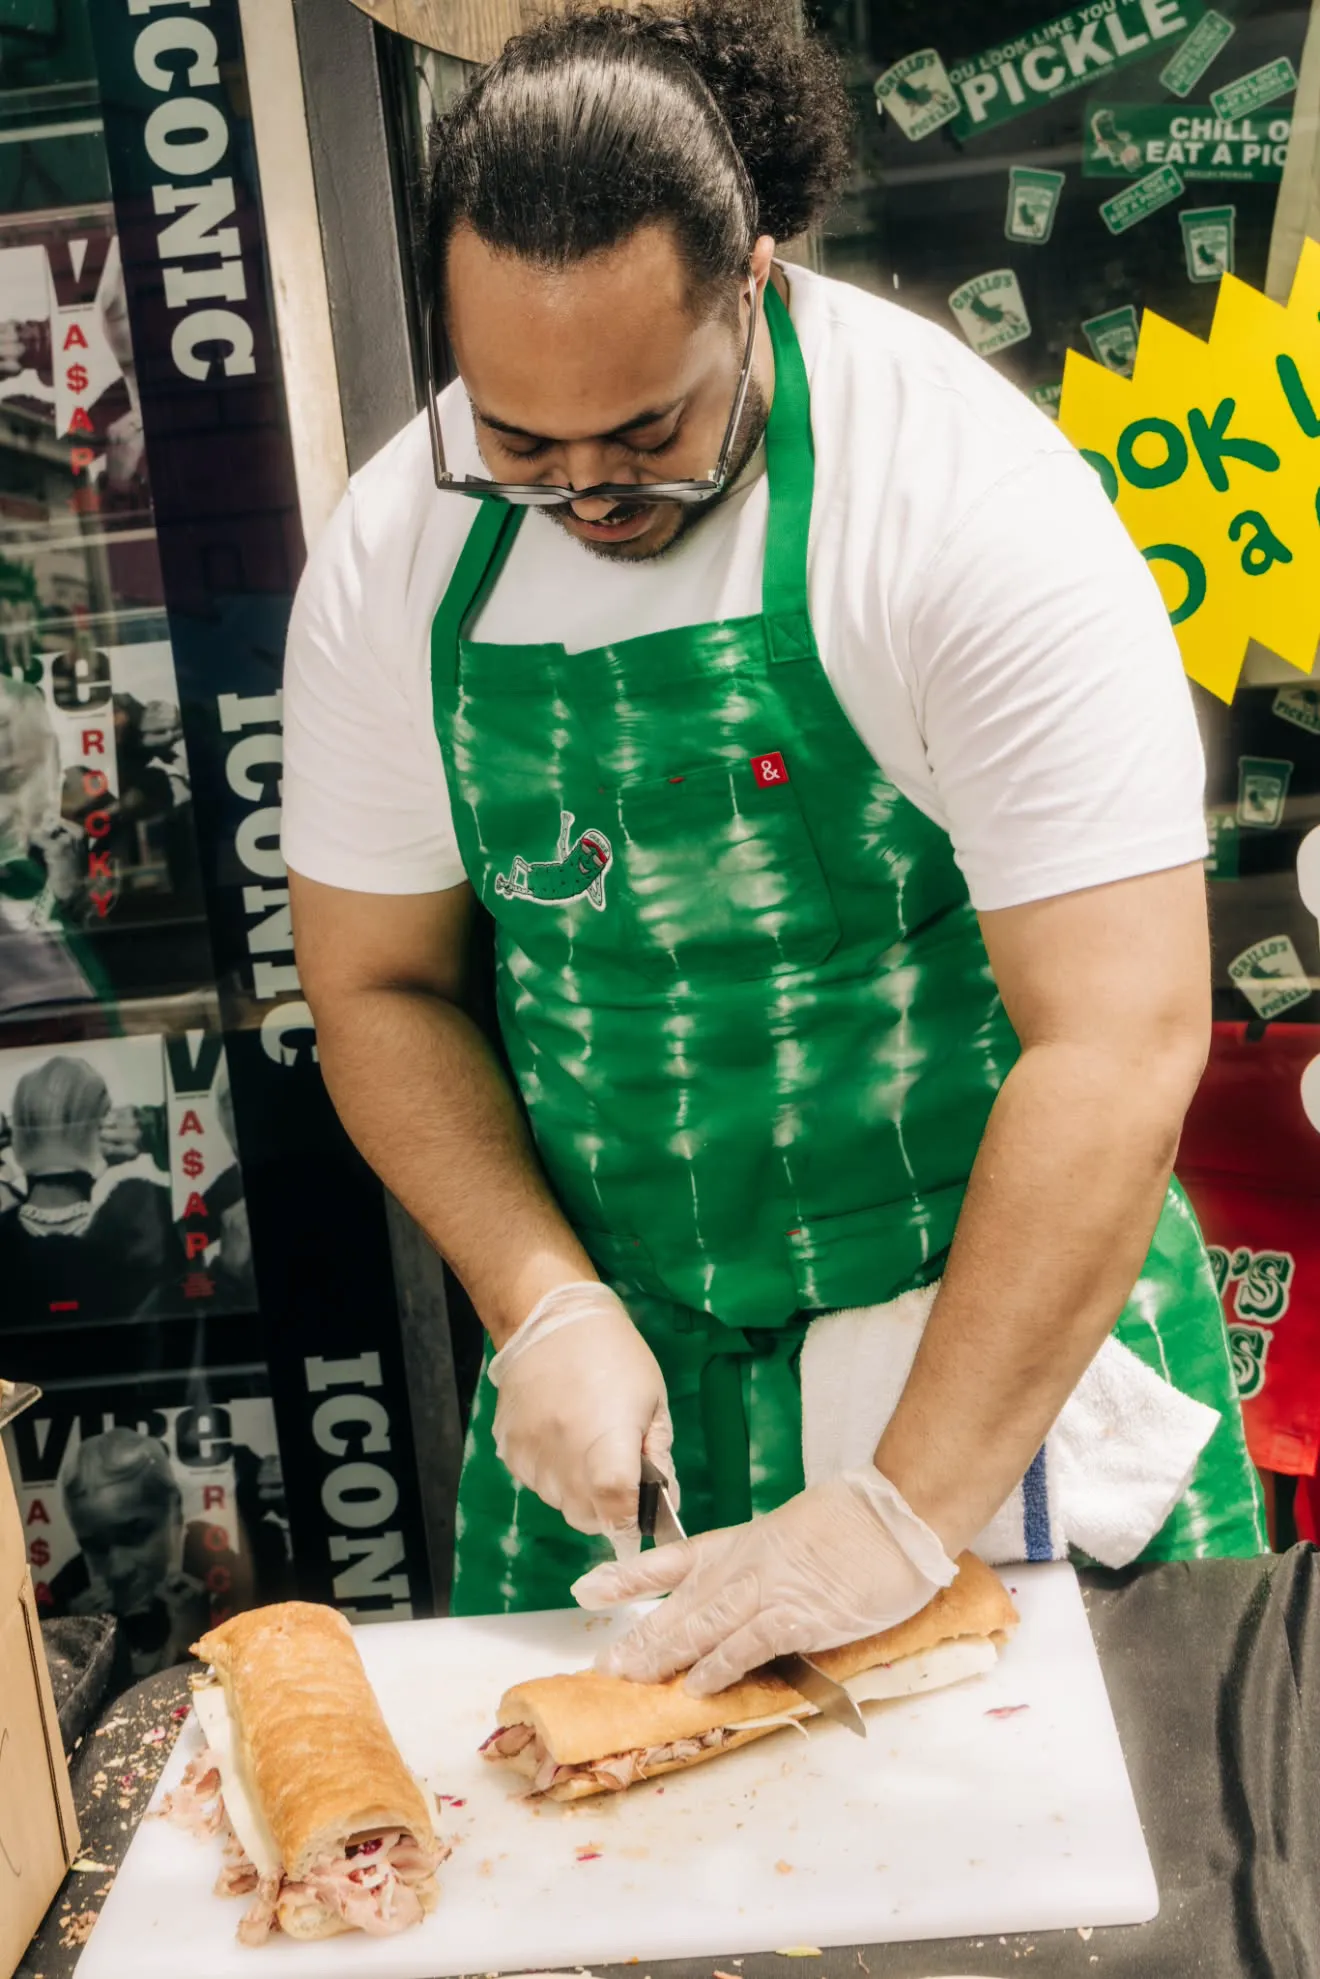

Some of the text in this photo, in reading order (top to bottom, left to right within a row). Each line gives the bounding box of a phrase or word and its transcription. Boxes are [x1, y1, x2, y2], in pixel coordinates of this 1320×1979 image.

[949, 62, 976, 84] OU
[979, 37, 1030, 70] LOOK
[1032, 16, 1076, 46] LIKE
[959, 0, 1188, 124] PICKLE
[1169, 117, 1260, 141] CHILL
[1146, 141, 1289, 167] EAT A PIC
